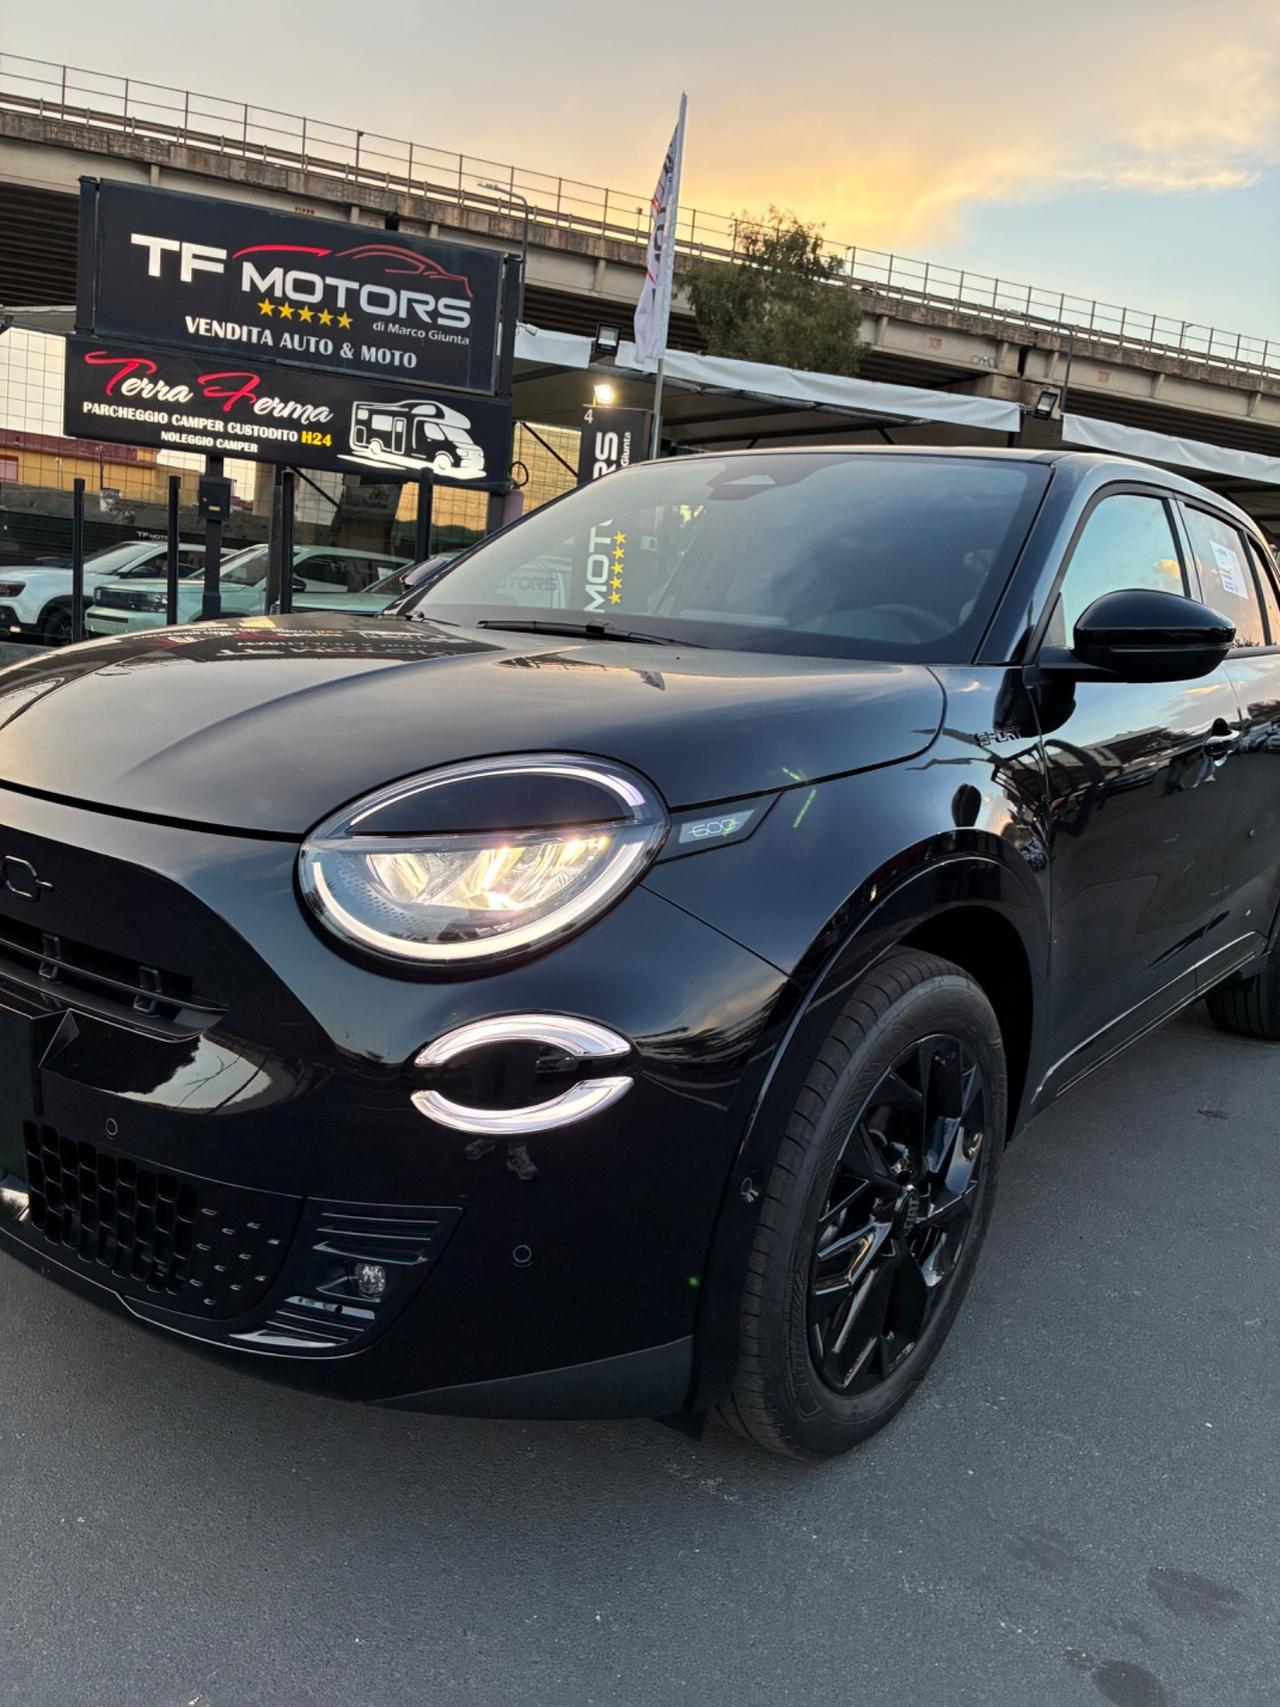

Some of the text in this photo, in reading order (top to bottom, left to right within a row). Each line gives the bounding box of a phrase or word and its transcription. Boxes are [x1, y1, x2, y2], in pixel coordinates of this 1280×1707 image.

[131, 233, 471, 329] TF MOTORS
[185, 315, 417, 369] VENDITA AUTO & MOTO
[372, 321, 475, 345] di Marco Giunta
[84, 350, 334, 425] Terra Ferma
[82, 401, 332, 447] PARCHEGGIO CAMPER CUSTODITO H24
[160, 431, 258, 453] NOLEGGIO CAMPER
[620, 431, 632, 468] Giunta
[583, 518, 613, 613] MOT
